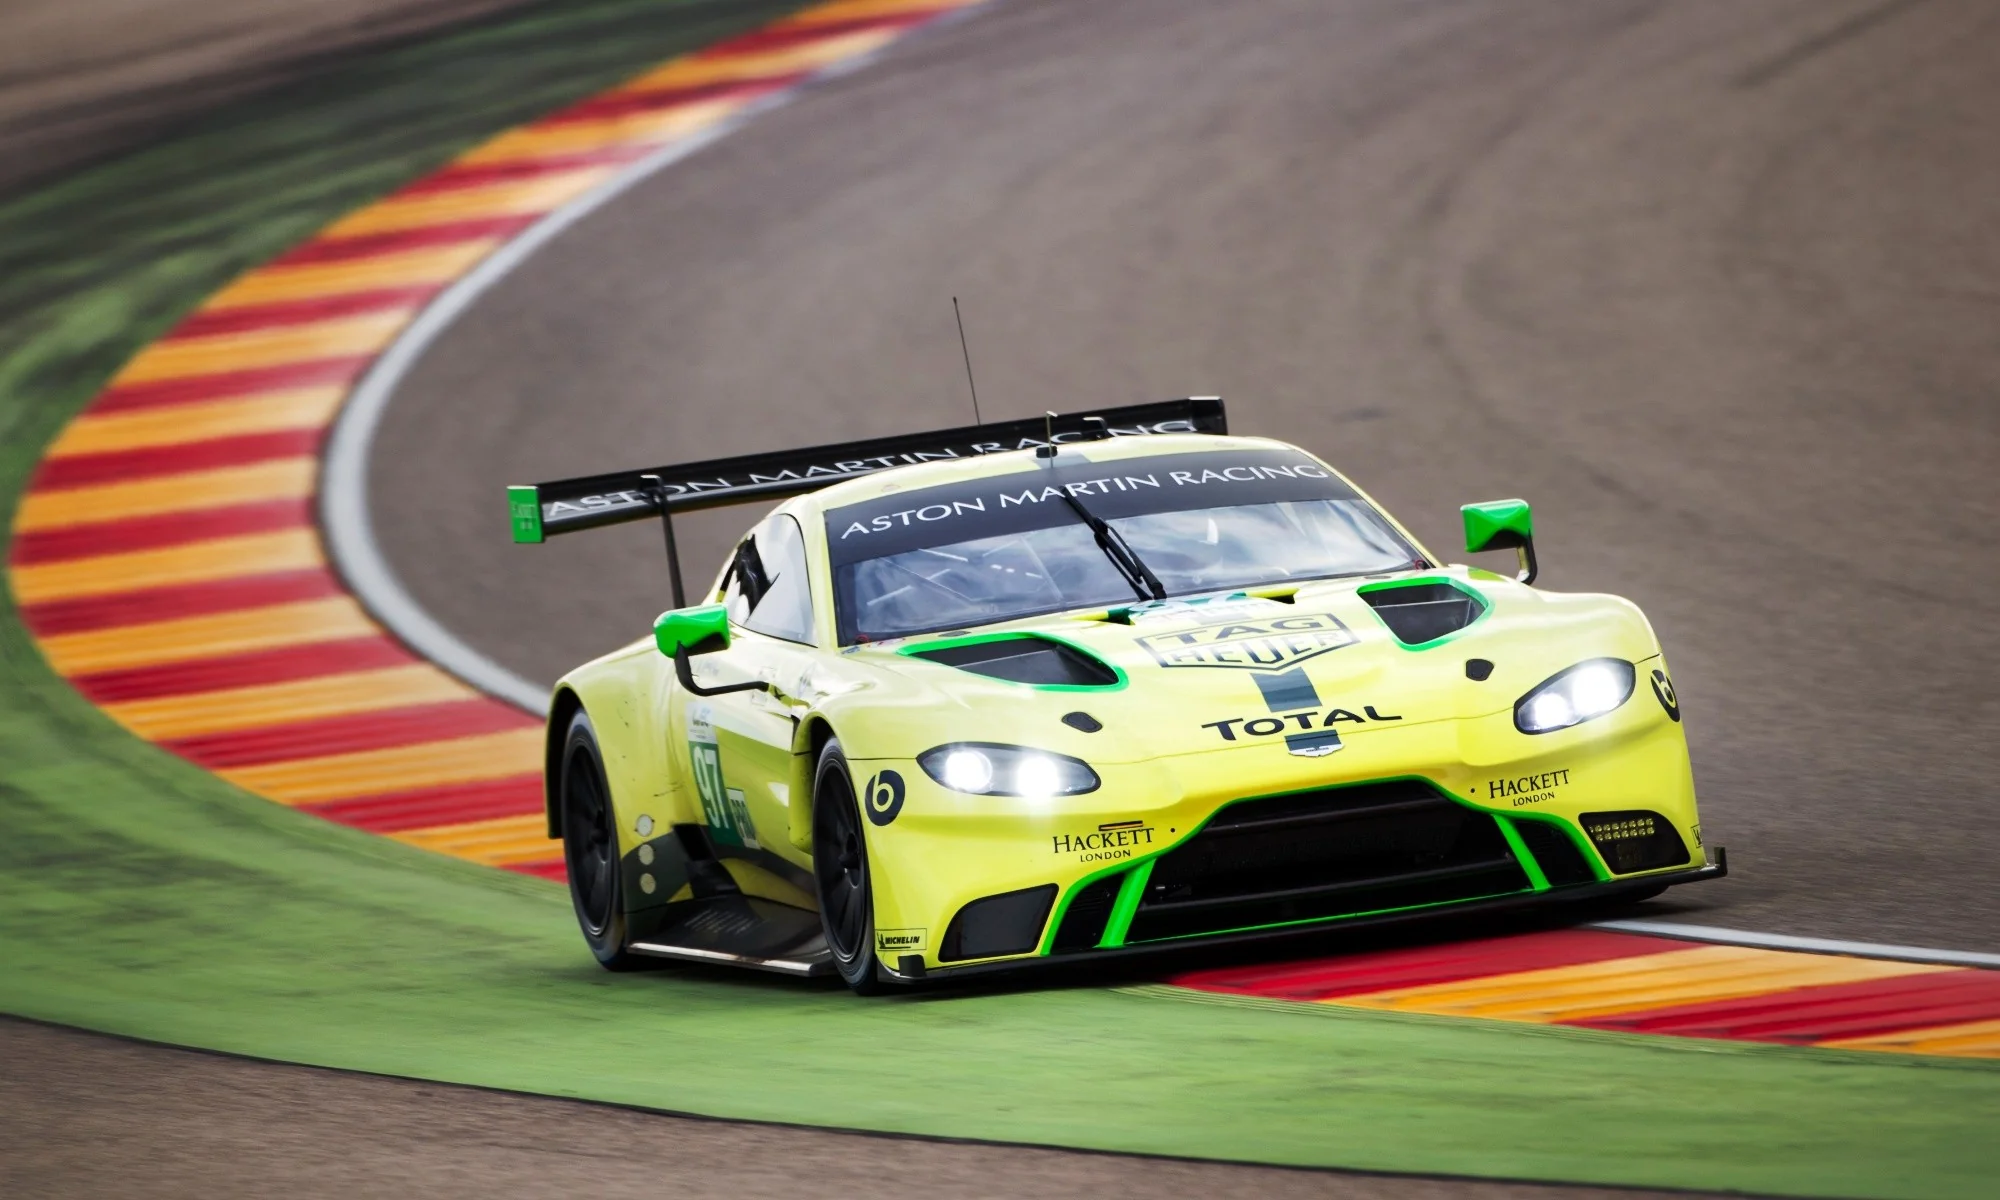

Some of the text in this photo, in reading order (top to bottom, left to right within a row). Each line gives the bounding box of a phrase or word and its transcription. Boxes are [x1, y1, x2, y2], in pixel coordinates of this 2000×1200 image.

[749, 447, 960, 485] MARTIN
[971, 420, 1198, 454] RACNG
[840, 463, 1332, 540] ASTON MARTIN RACING
[1156, 618, 1324, 645] TAG
[1166, 631, 1342, 664] HEUER
[1201, 705, 1403, 741] TOTAL
[693, 745, 730, 829] 97
[1488, 768, 1570, 800] HACKETT
[1513, 791, 1555, 807] LONDON
[1052, 827, 1155, 854] HACKETT
[1080, 849, 1132, 863] LONDON
[884, 935, 921, 945] MICHELIN
